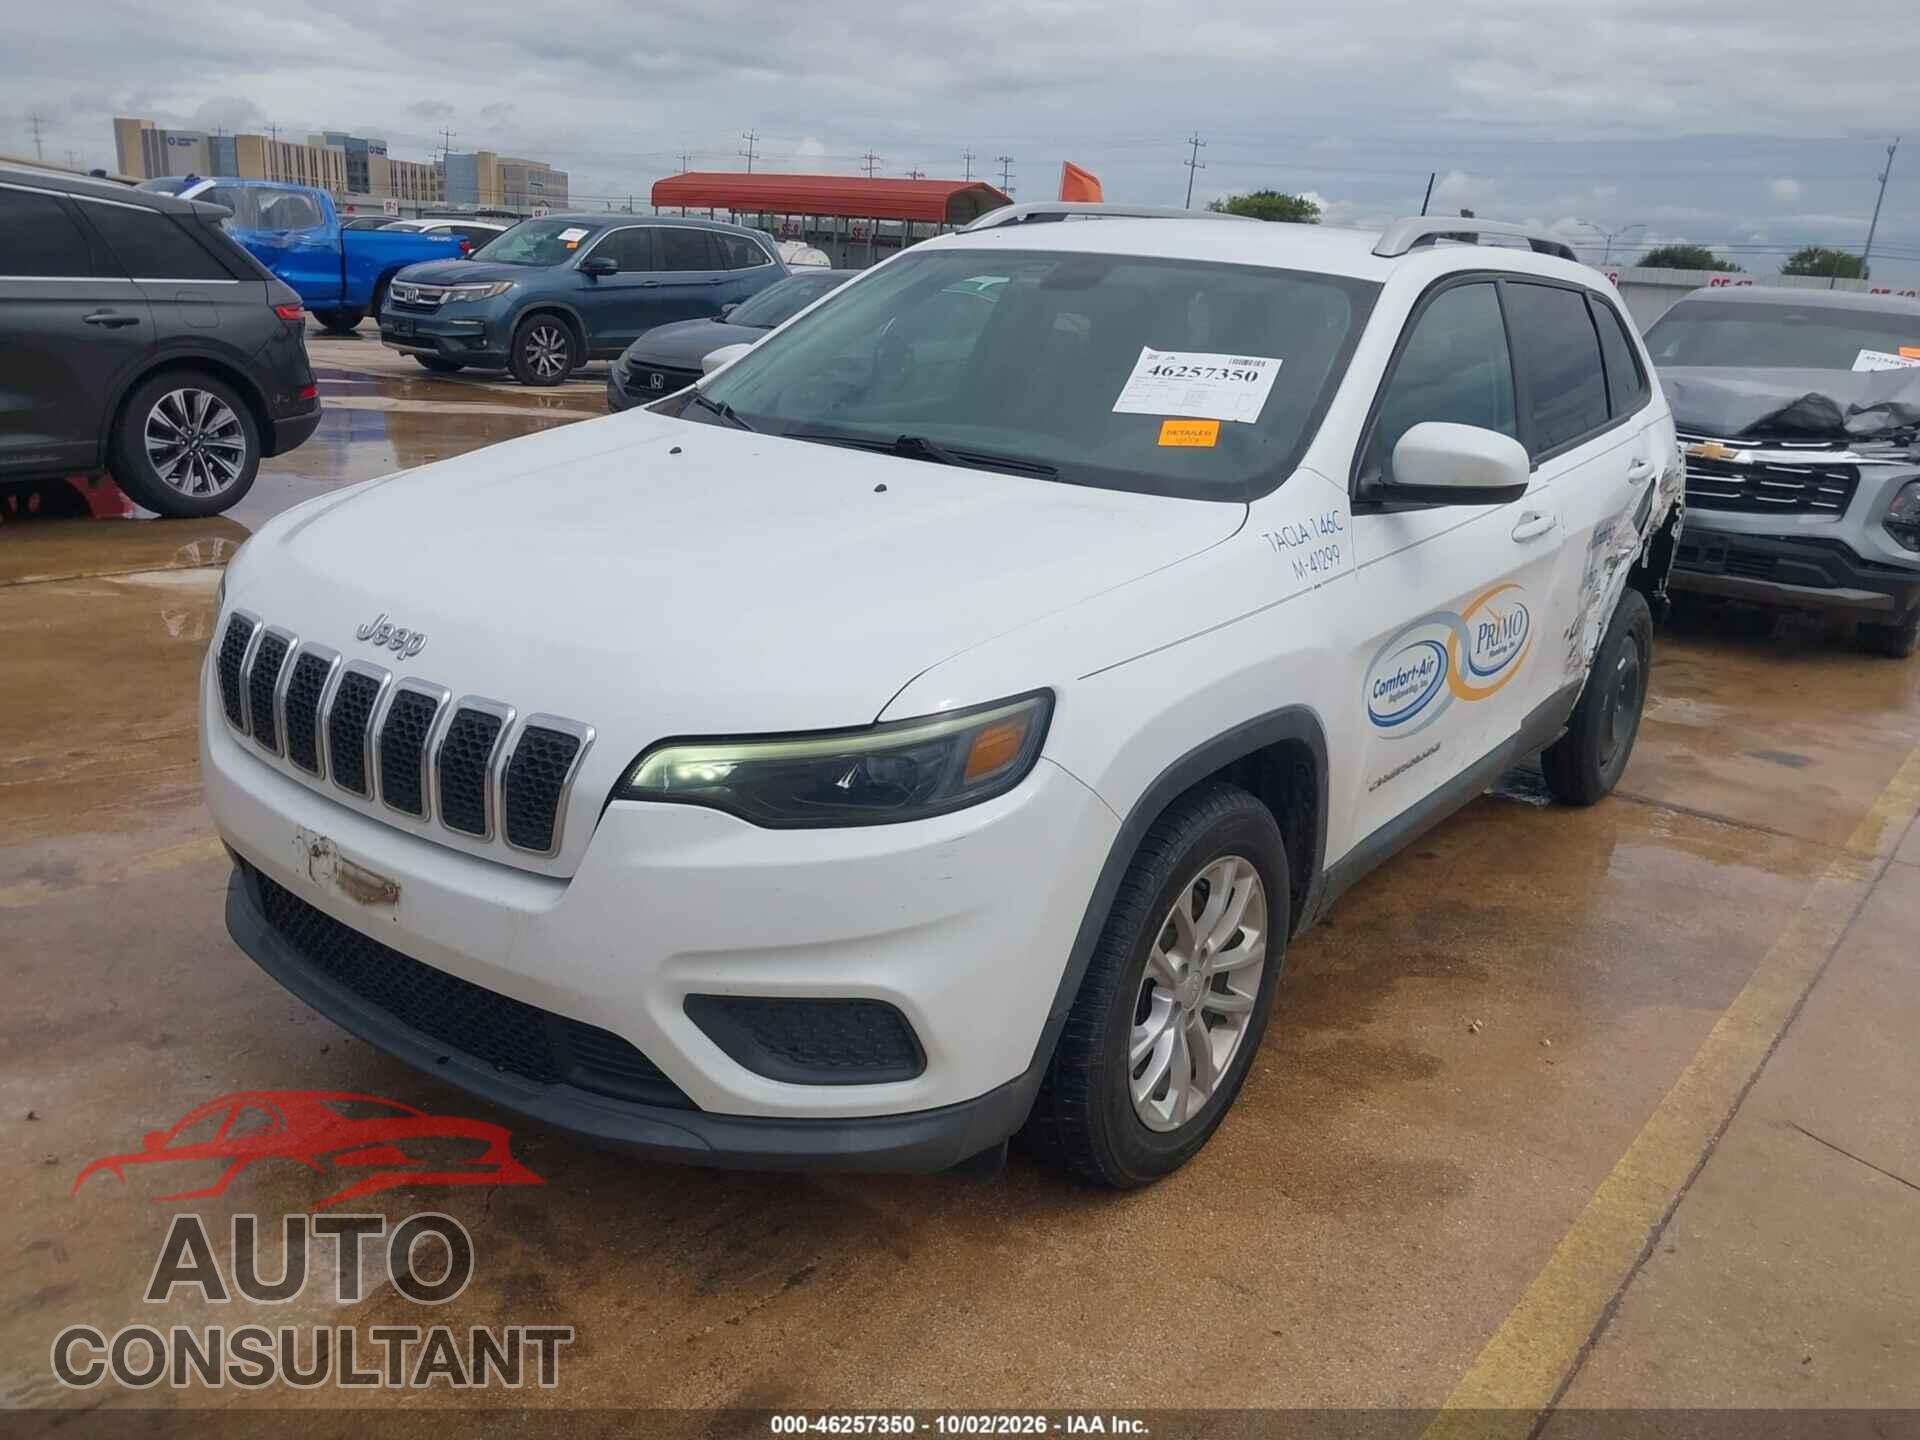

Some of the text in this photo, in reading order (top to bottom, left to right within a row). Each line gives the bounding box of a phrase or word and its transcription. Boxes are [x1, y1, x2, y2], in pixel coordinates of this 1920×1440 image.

[1147, 364, 1259, 383] 46257350
[357, 613, 427, 661] Jeep
[1373, 655, 1434, 699] Comfort-Air
